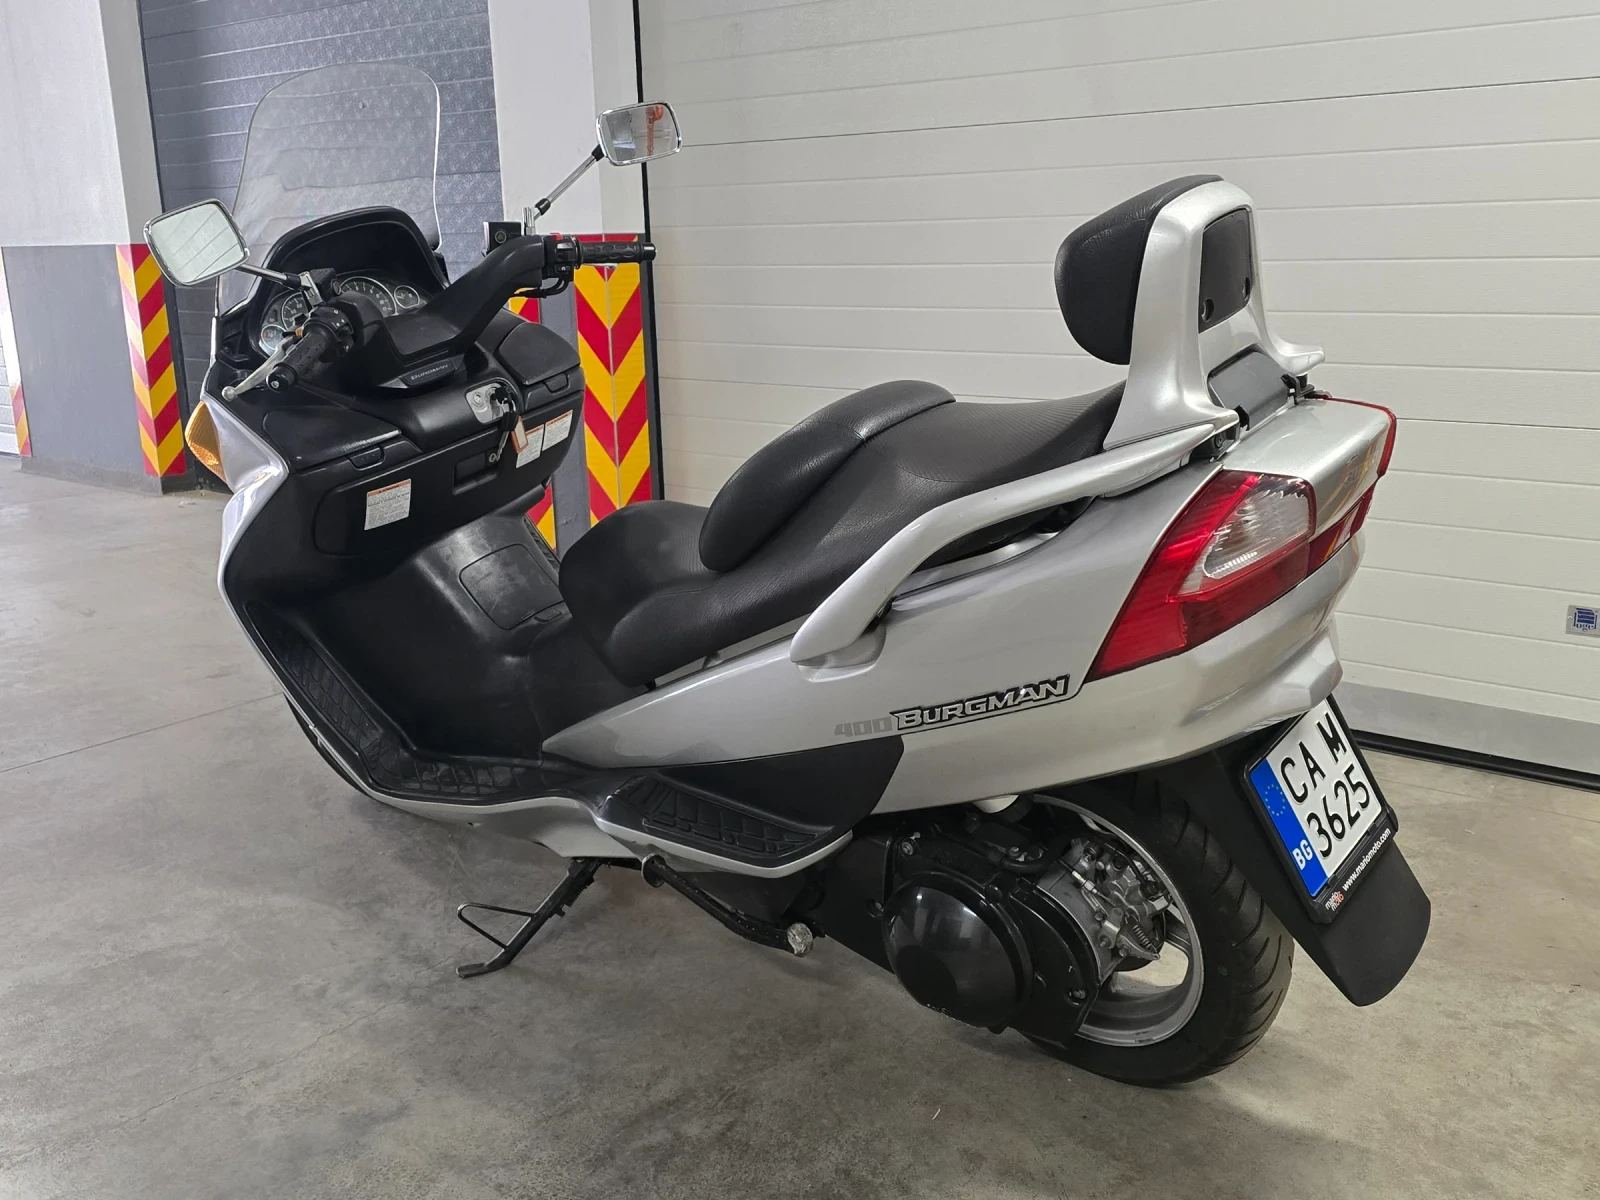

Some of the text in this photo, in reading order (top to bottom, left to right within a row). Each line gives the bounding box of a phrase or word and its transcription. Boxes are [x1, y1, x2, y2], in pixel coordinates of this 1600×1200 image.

[834, 677, 1067, 737] 400 BURGMAN
[1279, 712, 1347, 804] CA M
[1306, 763, 1371, 859] 3625
[1292, 839, 1314, 870] BG
[1342, 828, 1392, 892] www.mariomoto.com
